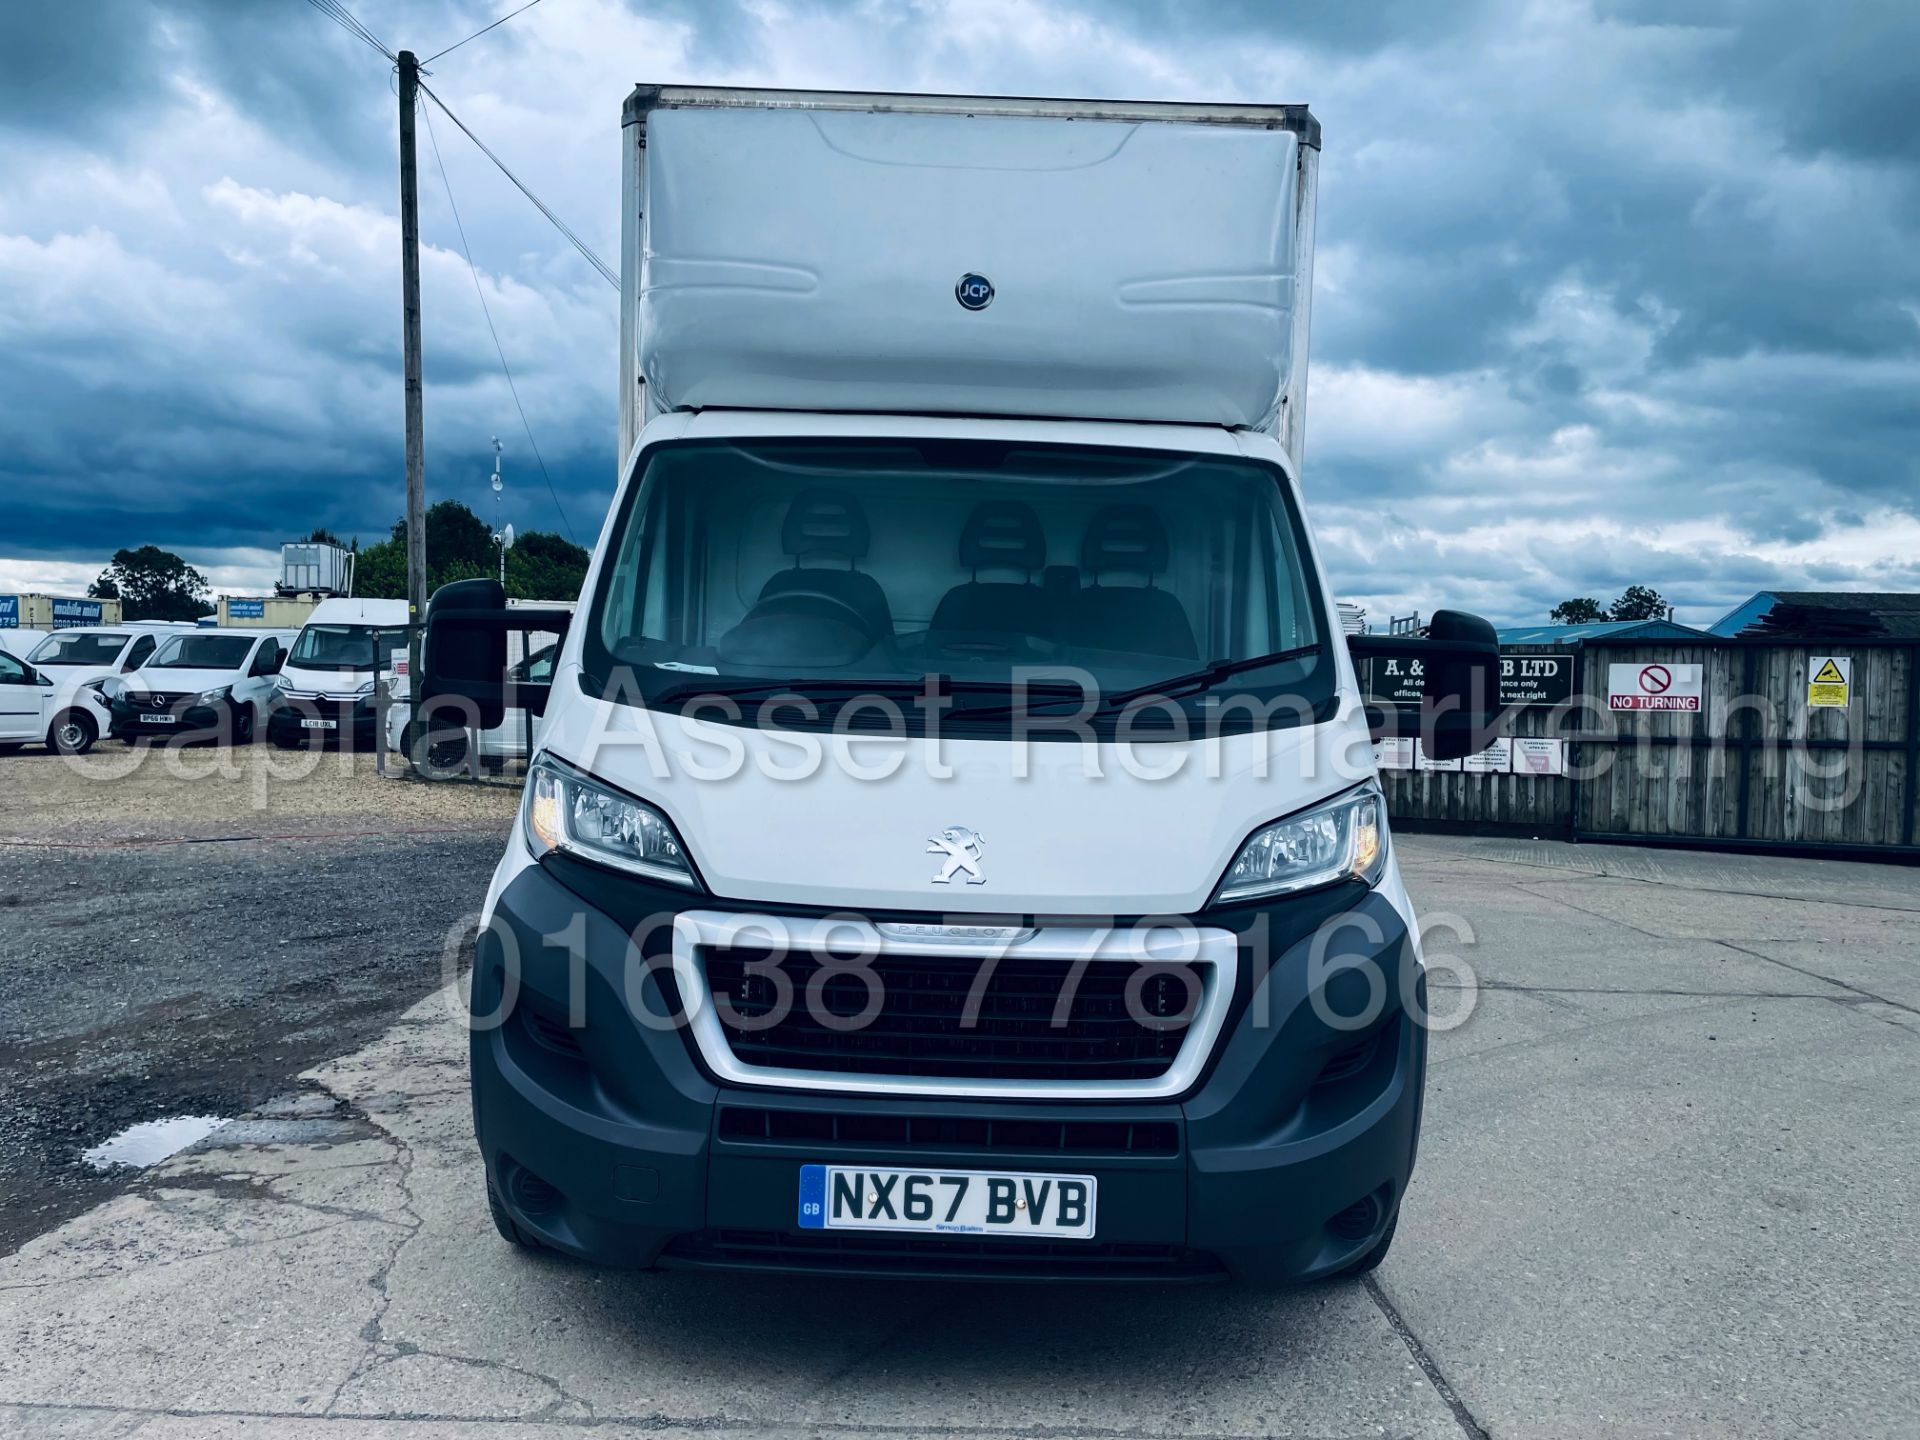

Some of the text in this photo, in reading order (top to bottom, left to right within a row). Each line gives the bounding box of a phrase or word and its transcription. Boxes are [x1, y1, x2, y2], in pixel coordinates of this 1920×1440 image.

[961, 284, 989, 298] JCP
[54, 601, 100, 618] mobile mini
[1385, 660, 1404, 676] A.
[1410, 660, 1424, 676] &
[1521, 660, 1558, 677] LTD
[1521, 680, 1538, 688] only
[1507, 691, 1525, 699] next
[1527, 691, 1546, 700] right
[1613, 696, 1696, 709] NO TURNING
[898, 925, 1012, 938] PEUGEOT
[833, 1172, 1087, 1227] NX67 BVB
[803, 1202, 820, 1215] GB
